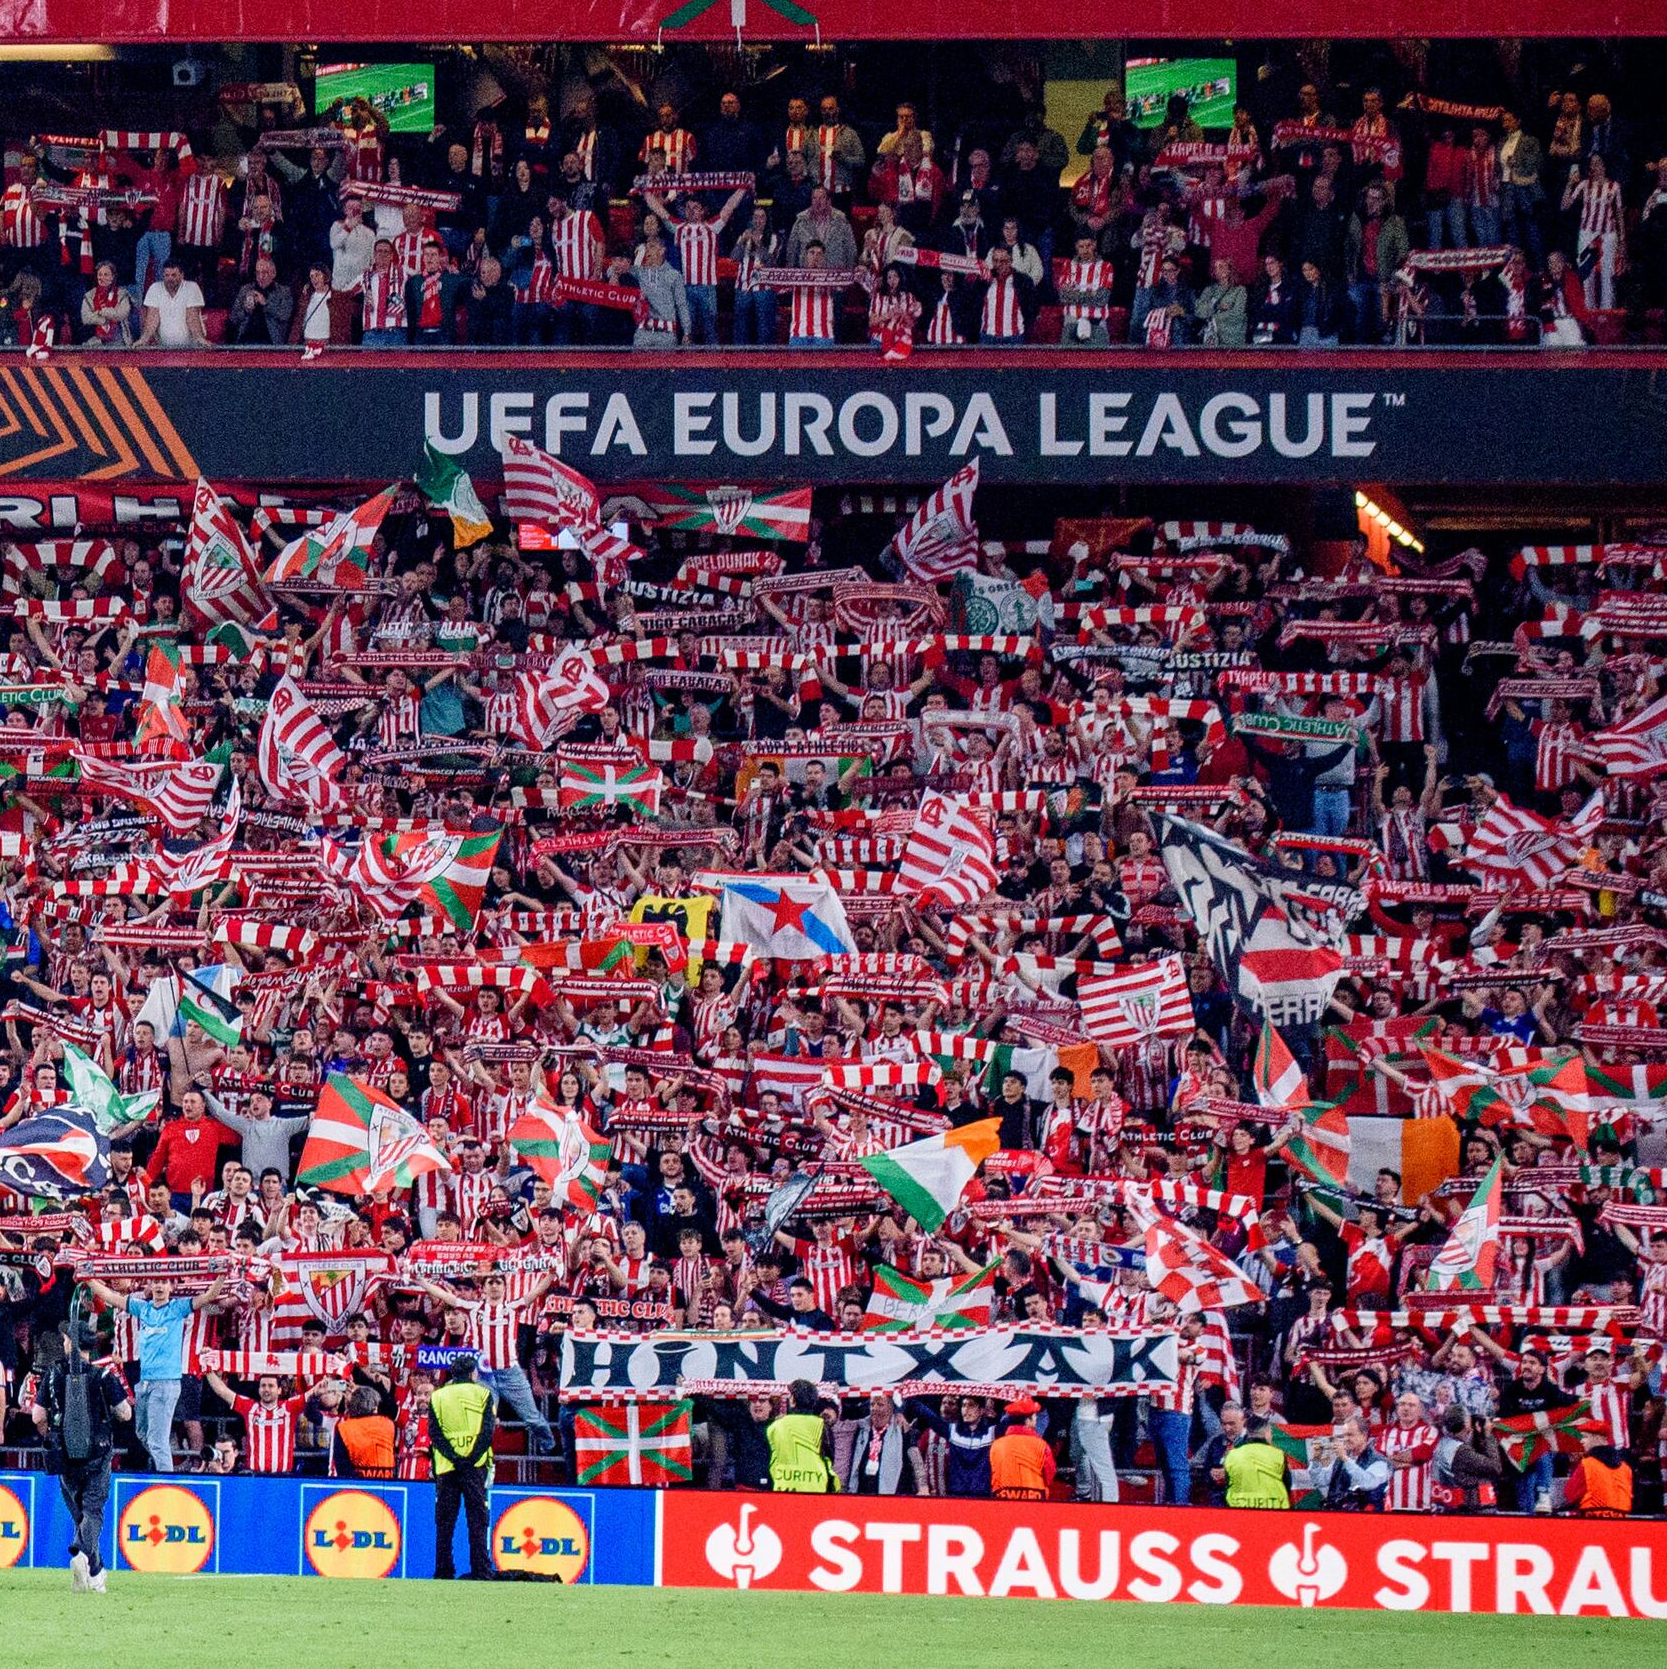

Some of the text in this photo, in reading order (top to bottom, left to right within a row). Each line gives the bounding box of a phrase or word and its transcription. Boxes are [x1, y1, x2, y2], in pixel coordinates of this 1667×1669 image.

[558, 280, 637, 304] ATHLETIC CLUB
[426, 393, 1376, 457] UEFA EUROPA LEAGUE
[1165, 653, 1250, 669] JUSTIZIA
[30, 687, 66, 701] CLUB
[1286, 722, 1347, 739] ATHLETIC
[218, 1077, 315, 1097] ATHLETIC CLUB
[724, 1125, 820, 1154] ATHLETIC CLUB
[1119, 1129, 1213, 1143] ATHLETIC CLUB
[103, 1260, 200, 1274] ATHLETIC CLUB
[128, 1515, 207, 1545] LIDL
[315, 1521, 394, 1551] LIDL
[501, 1527, 582, 1557] LIDL
[811, 1522, 1244, 1605] STRAUSS
